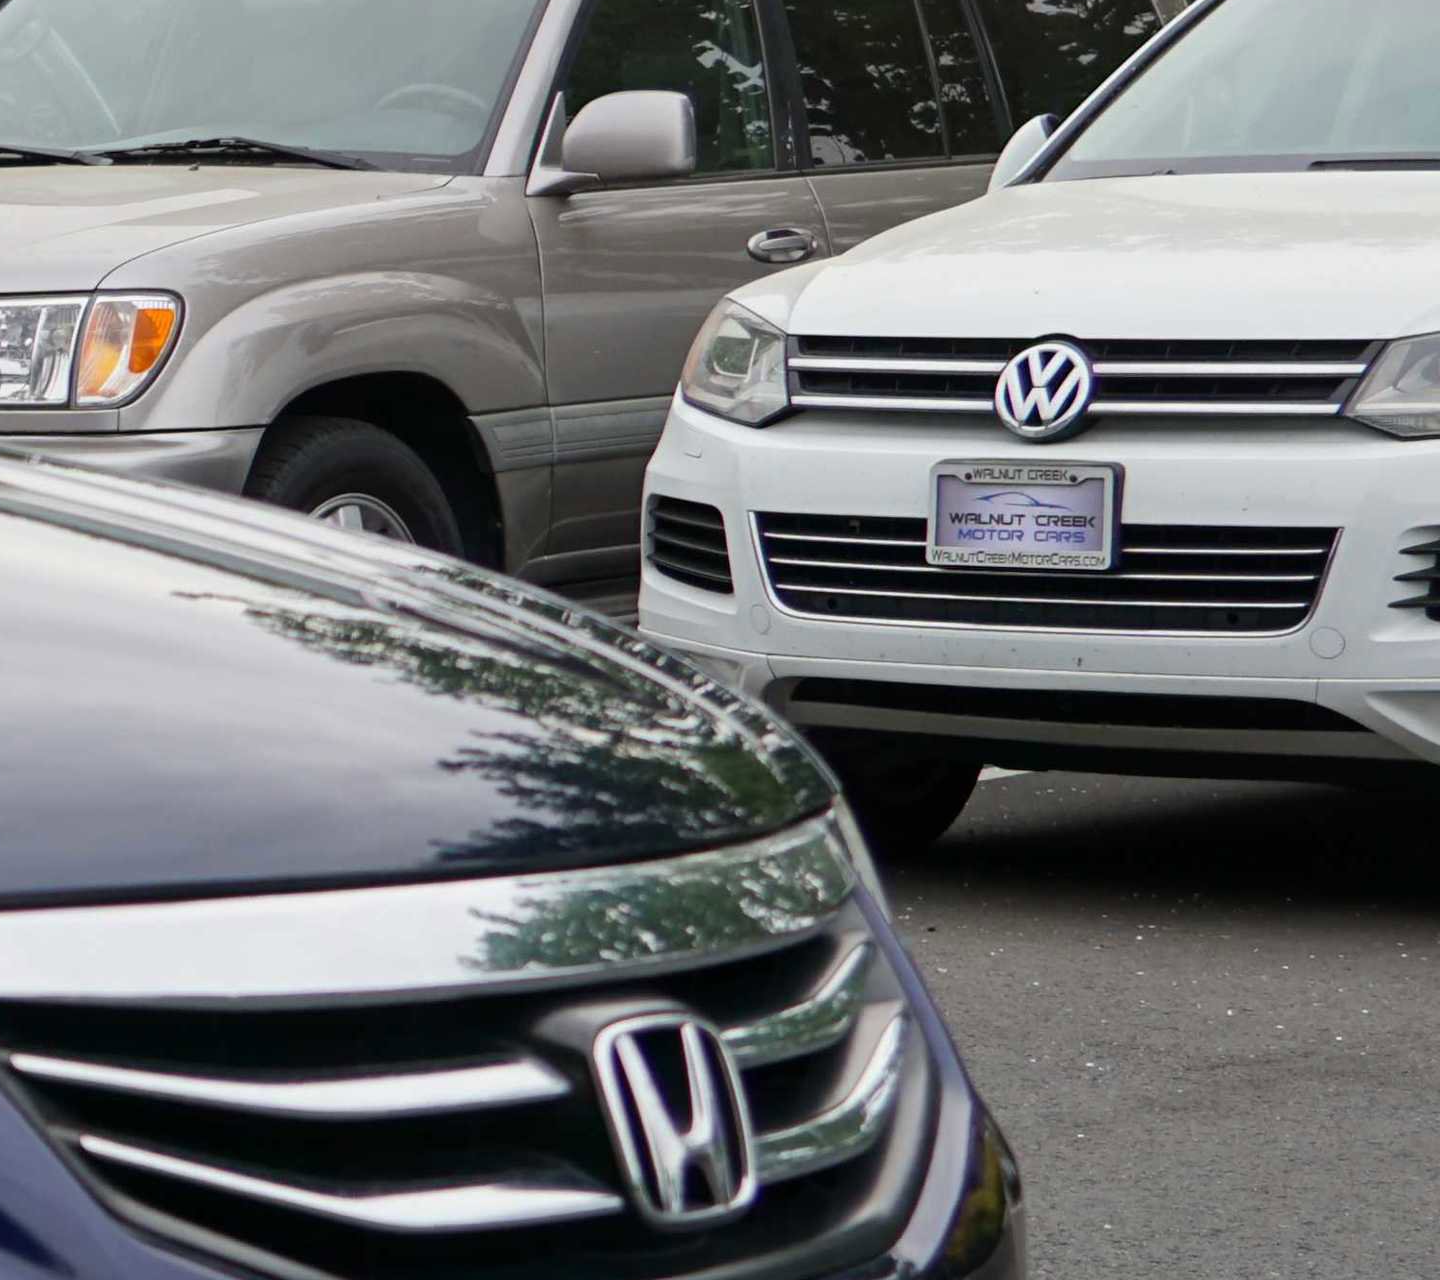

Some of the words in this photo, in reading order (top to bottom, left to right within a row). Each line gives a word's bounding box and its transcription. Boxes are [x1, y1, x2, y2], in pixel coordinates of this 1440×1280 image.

[972, 468, 1023, 480] WALNUT
[1027, 469, 1069, 481] CREEK
[949, 512, 1026, 526] WALNUT
[1034, 514, 1097, 528] CREEK
[957, 529, 1025, 543] MOTOR
[1033, 530, 1086, 543] CARS
